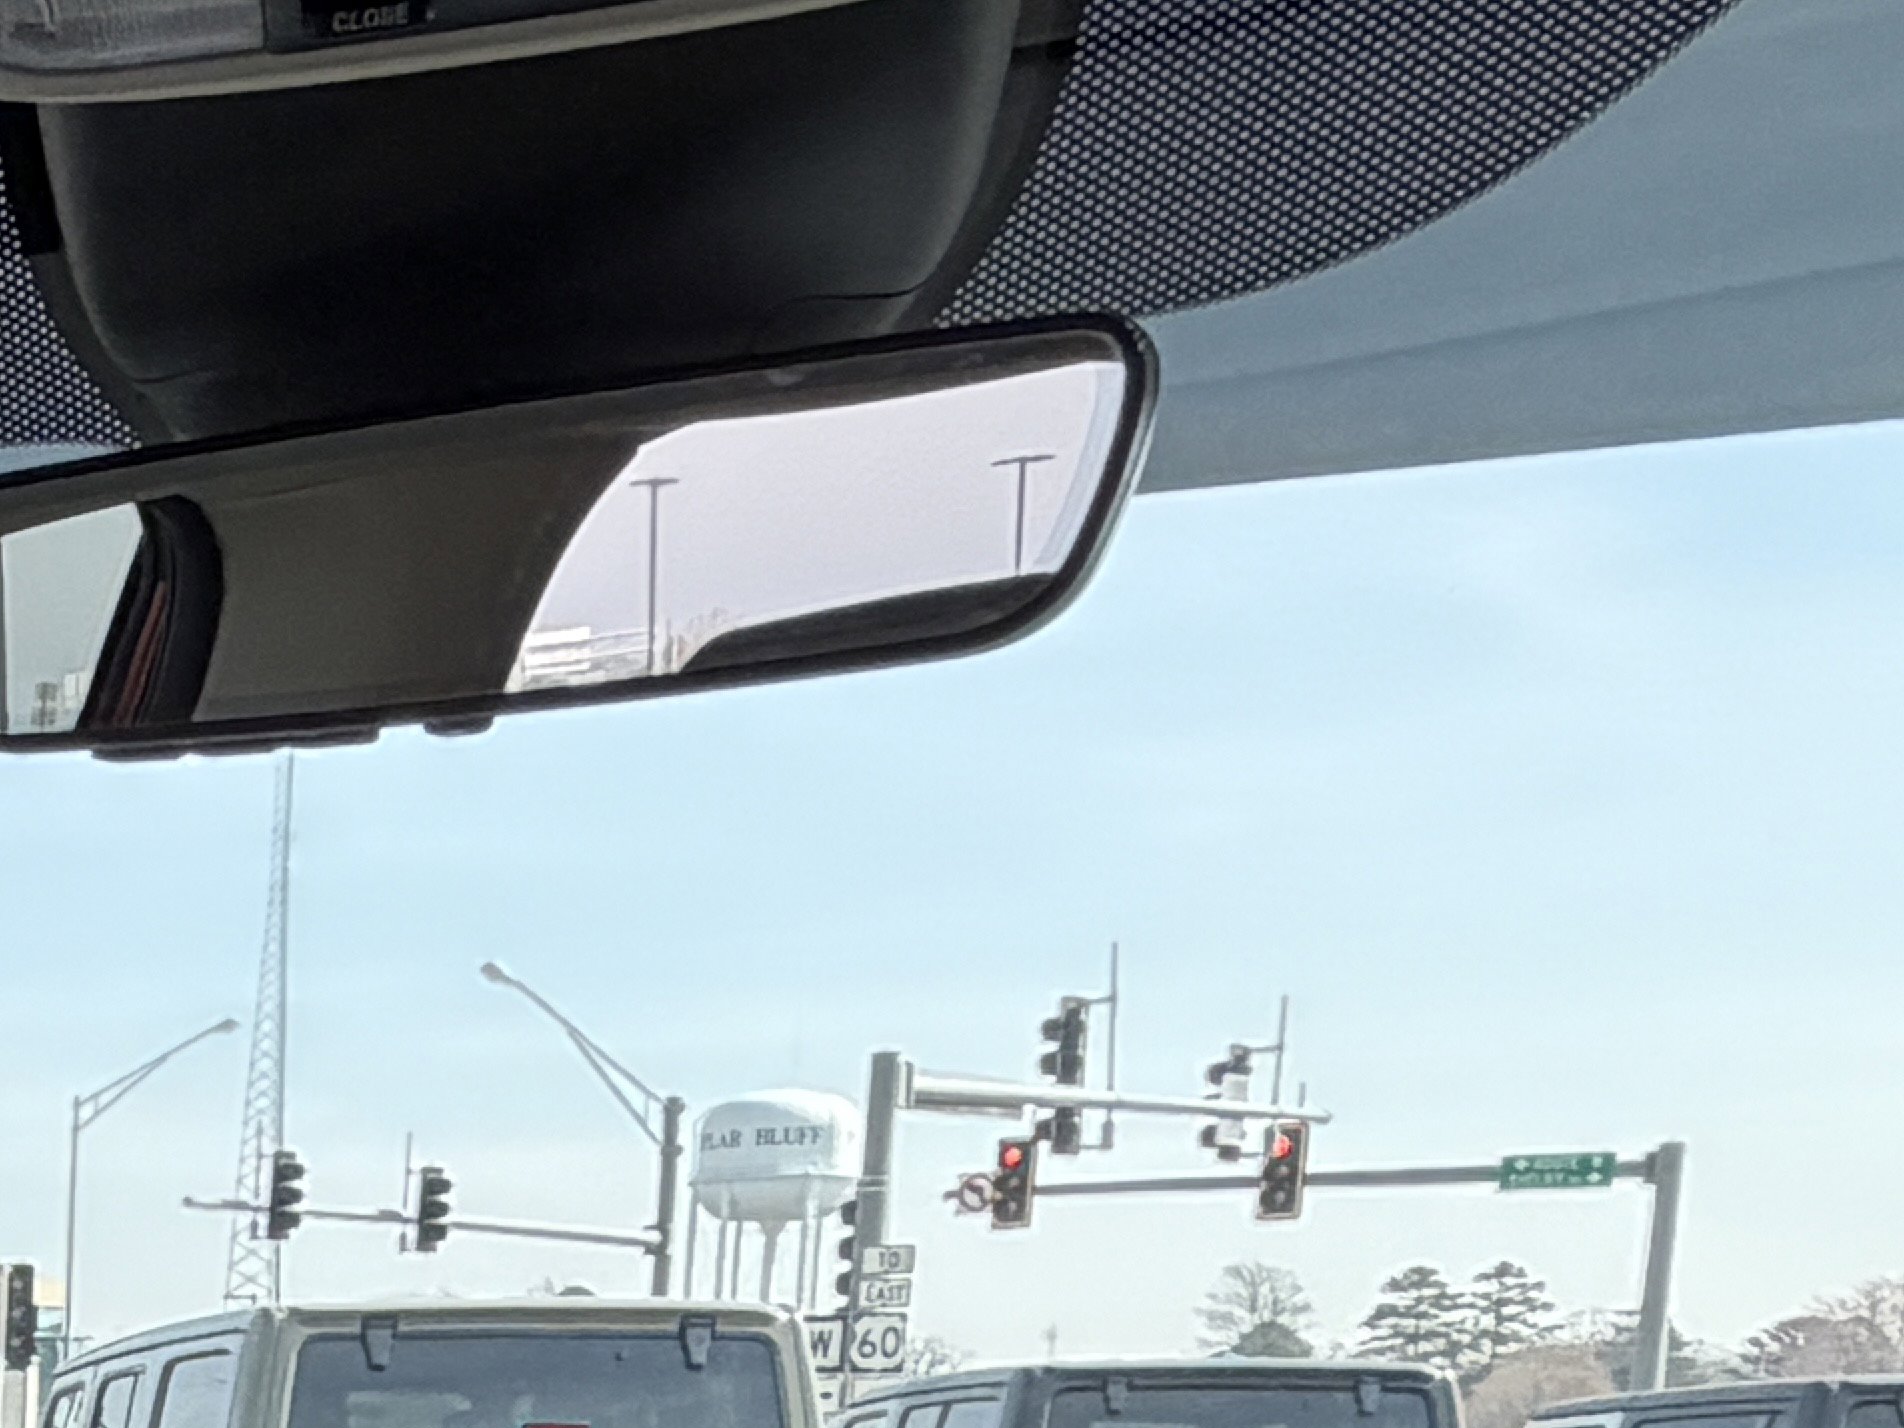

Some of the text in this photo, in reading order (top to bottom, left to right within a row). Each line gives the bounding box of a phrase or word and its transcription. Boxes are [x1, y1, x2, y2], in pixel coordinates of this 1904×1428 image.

[755, 1125, 825, 1146] BLUFF
[879, 1251, 900, 1268] TO
[858, 1326, 900, 1360] 60
